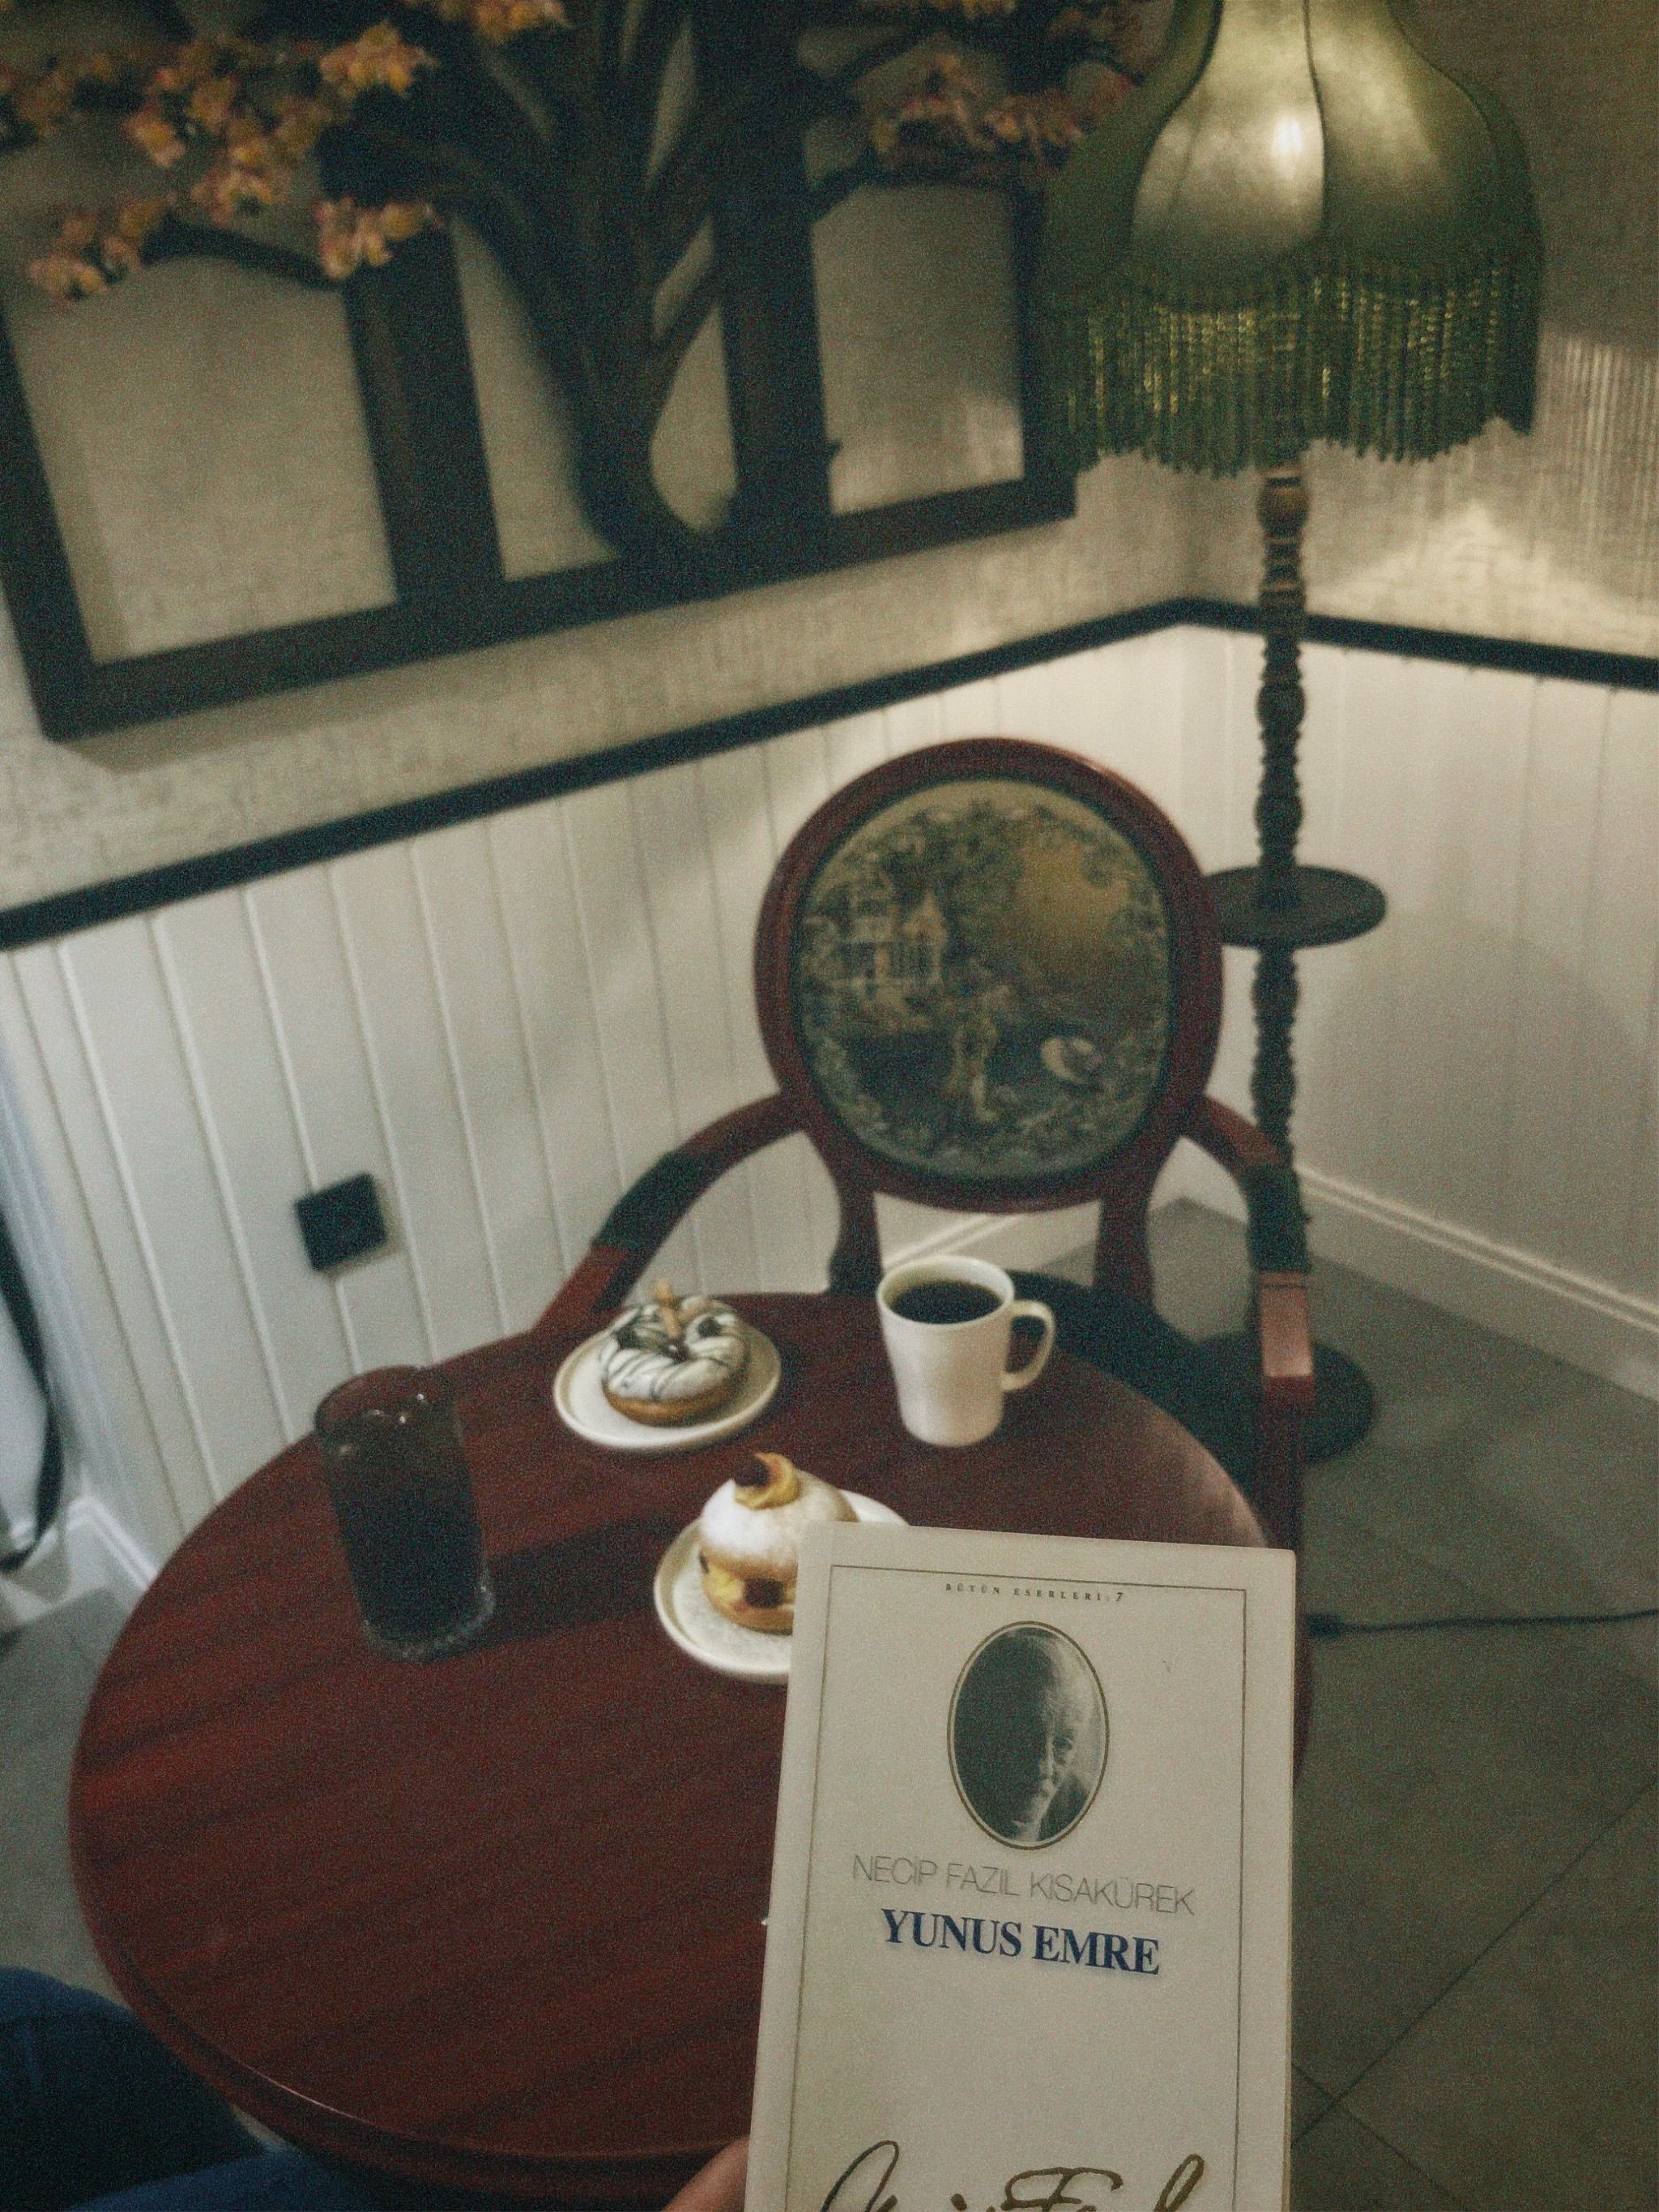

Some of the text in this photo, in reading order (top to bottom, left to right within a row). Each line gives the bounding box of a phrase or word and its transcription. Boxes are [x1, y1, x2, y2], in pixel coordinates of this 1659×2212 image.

[946, 1863, 1021, 1896] FAZIL
[1030, 1872, 1195, 1916] KISAKÜREK
[881, 1907, 1159, 1975] YUNUS EMRE
